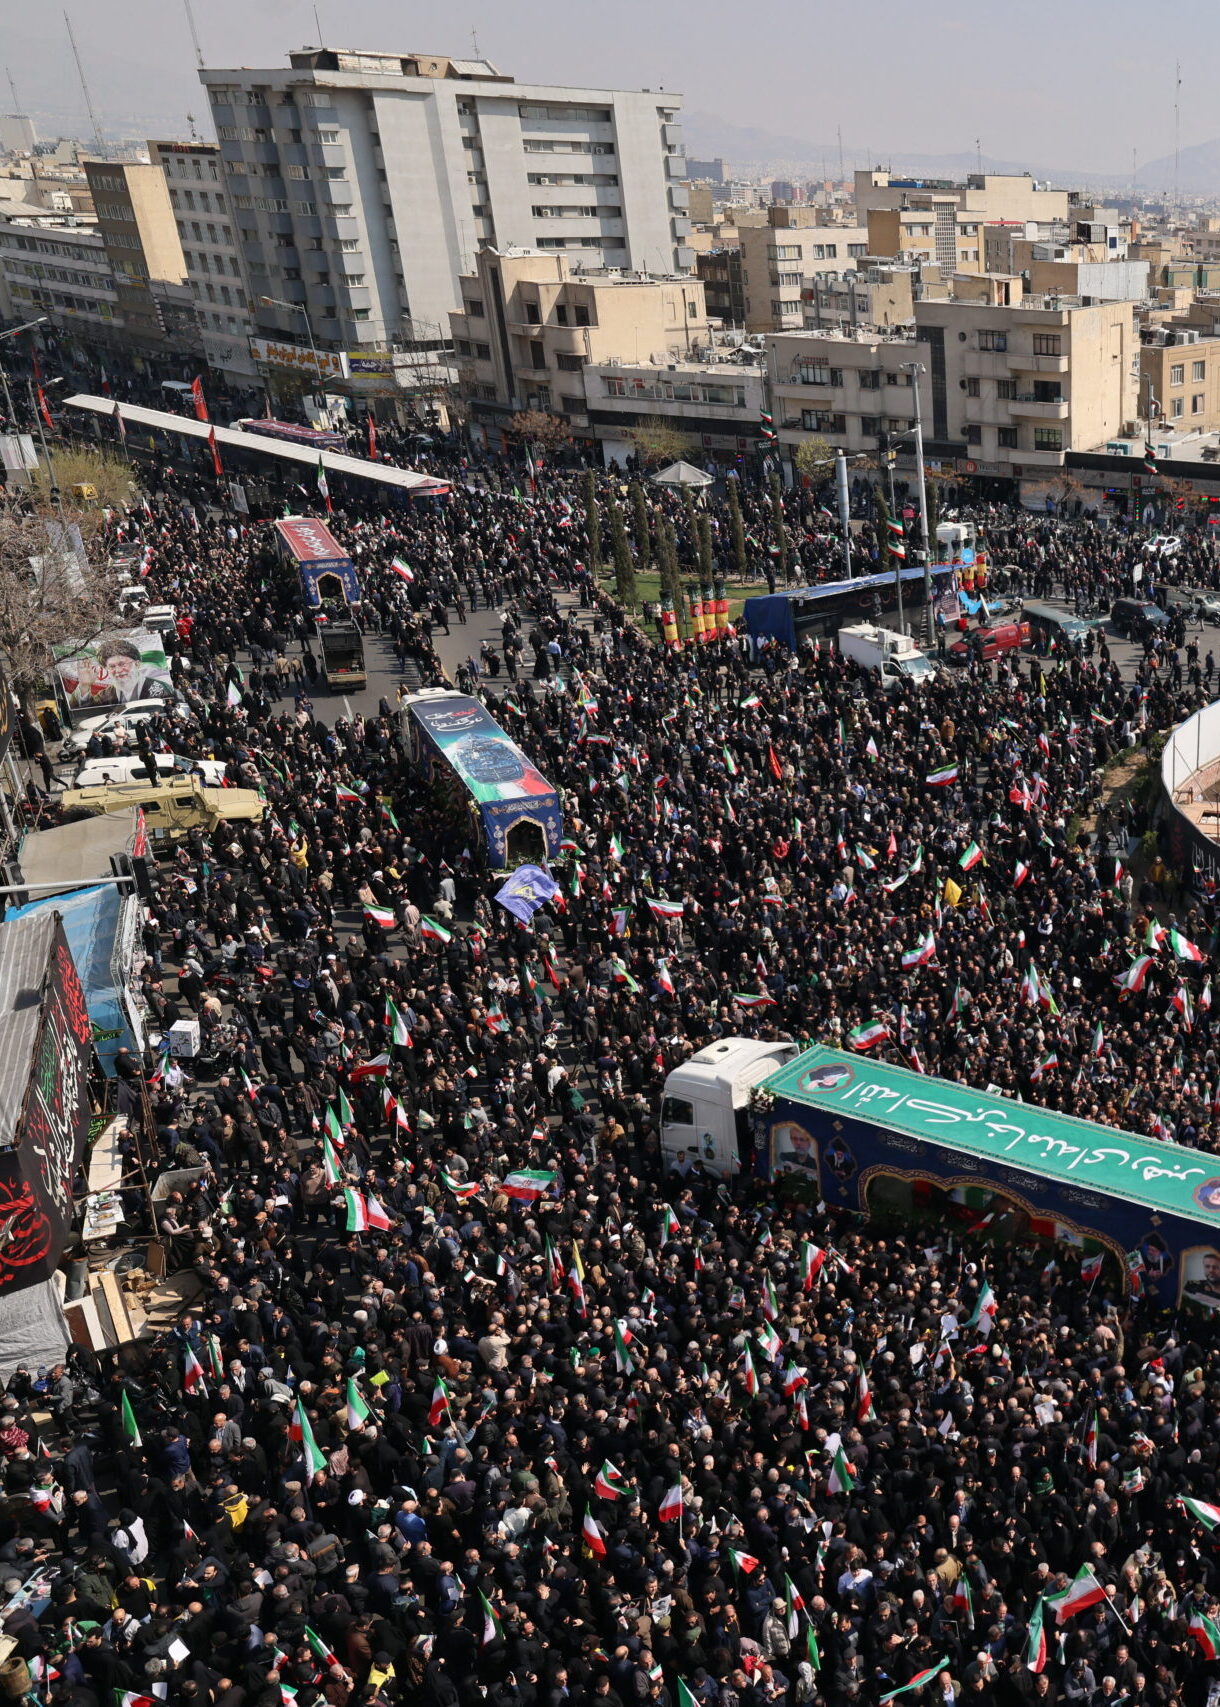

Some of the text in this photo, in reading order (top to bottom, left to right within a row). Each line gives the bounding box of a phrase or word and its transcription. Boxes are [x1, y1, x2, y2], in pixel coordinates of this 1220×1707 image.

[841, 1081, 900, 1108] الله
[886, 1094, 1008, 1123] اکبر
[1132, 1156, 1206, 1181] رهبر
